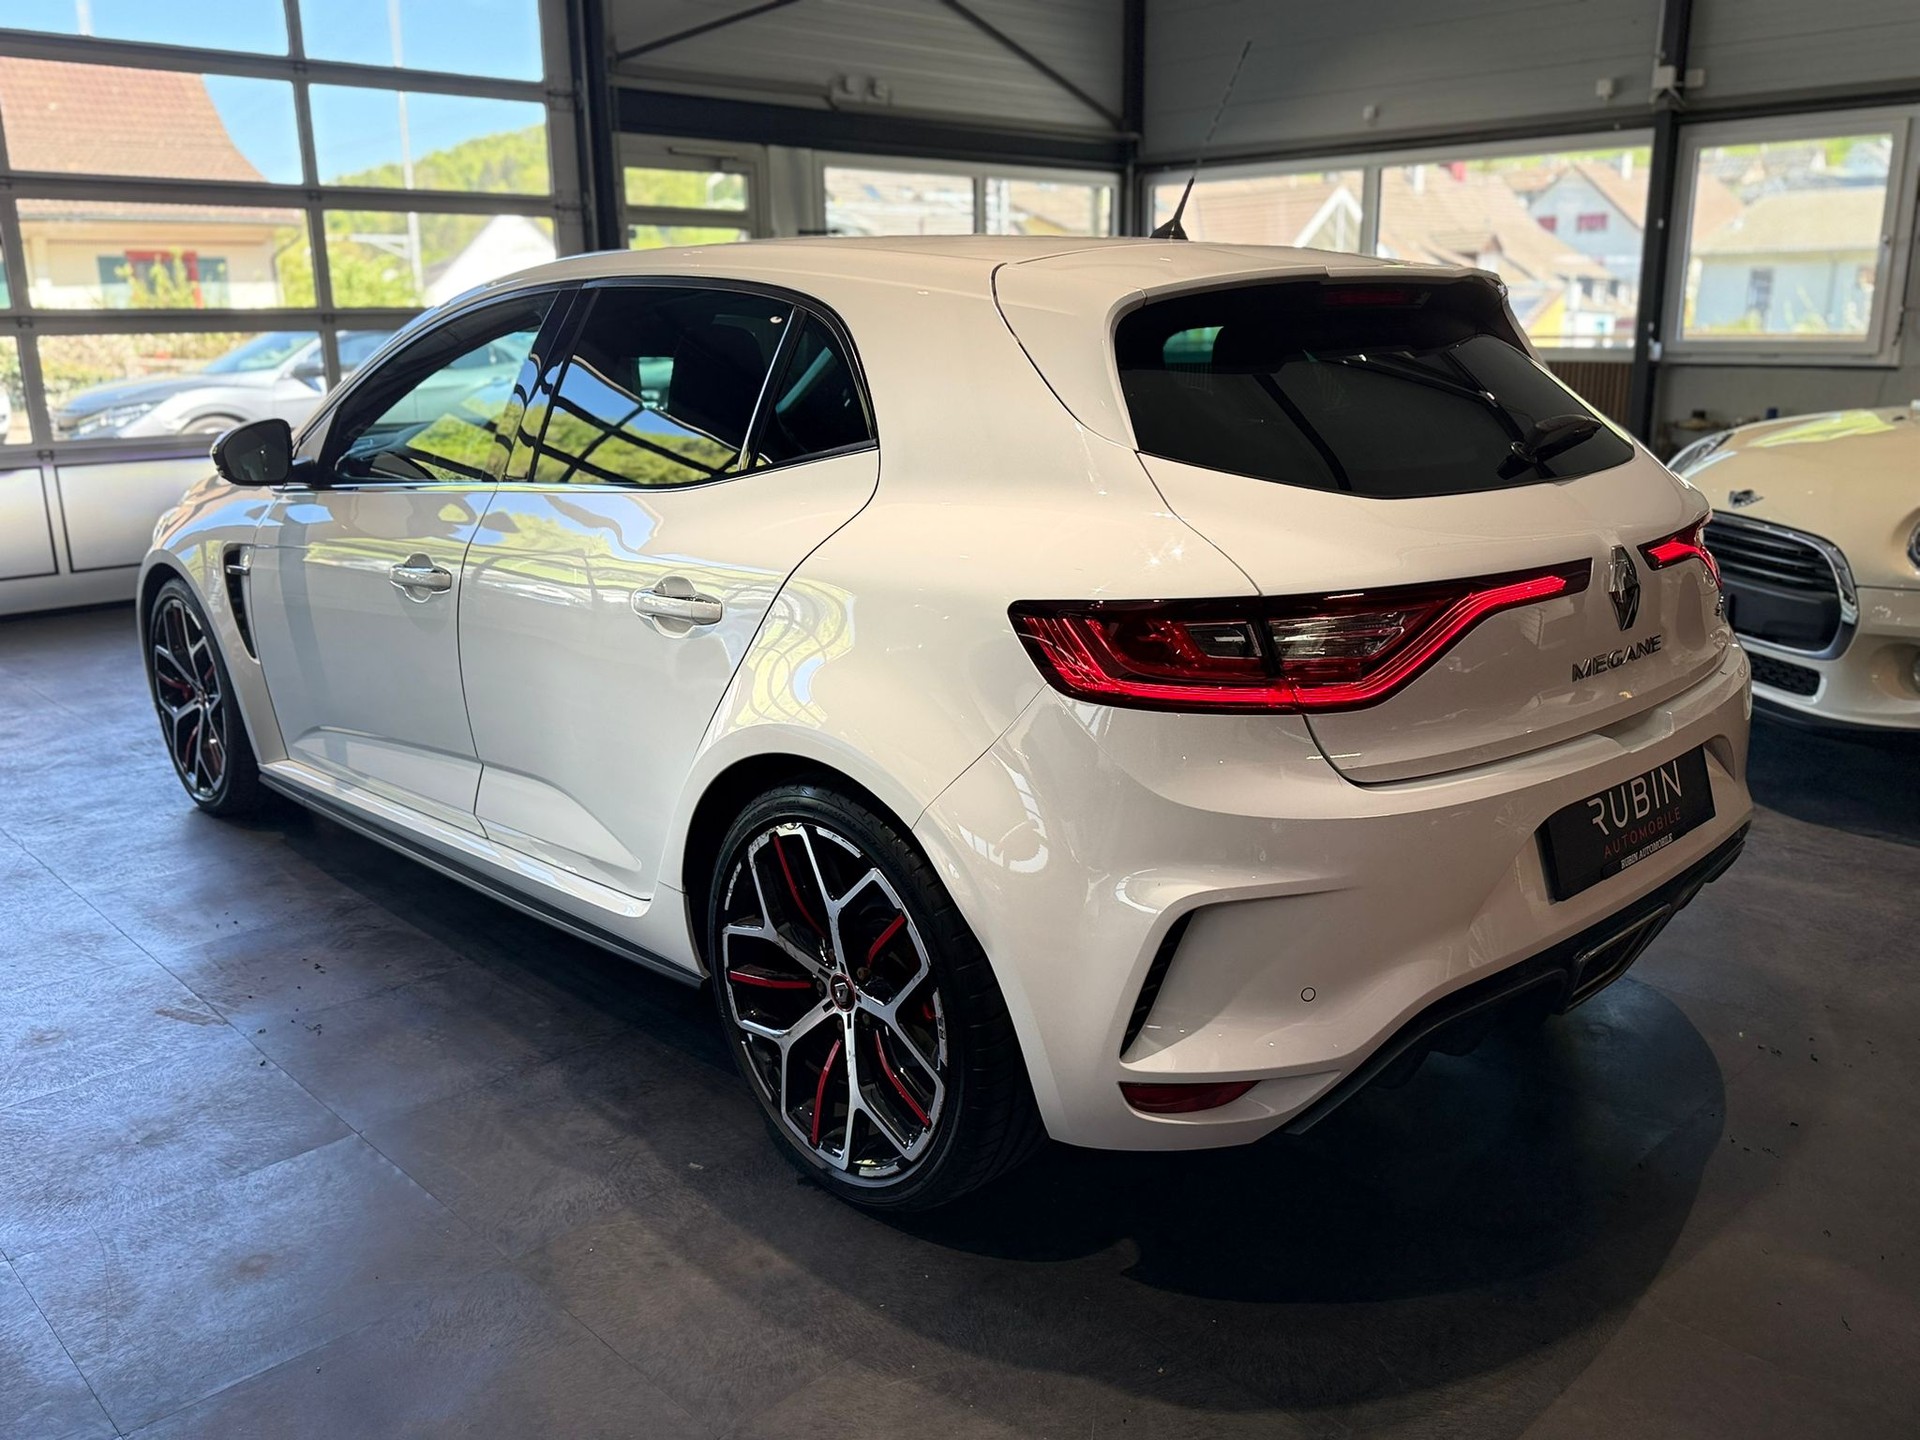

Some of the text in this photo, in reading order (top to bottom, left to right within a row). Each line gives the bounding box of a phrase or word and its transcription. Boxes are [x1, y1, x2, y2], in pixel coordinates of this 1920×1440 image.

[1572, 634, 1662, 682] MEGANE
[1586, 760, 1682, 836] RUBIN
[1603, 806, 1681, 859] AUTOMOBILE
